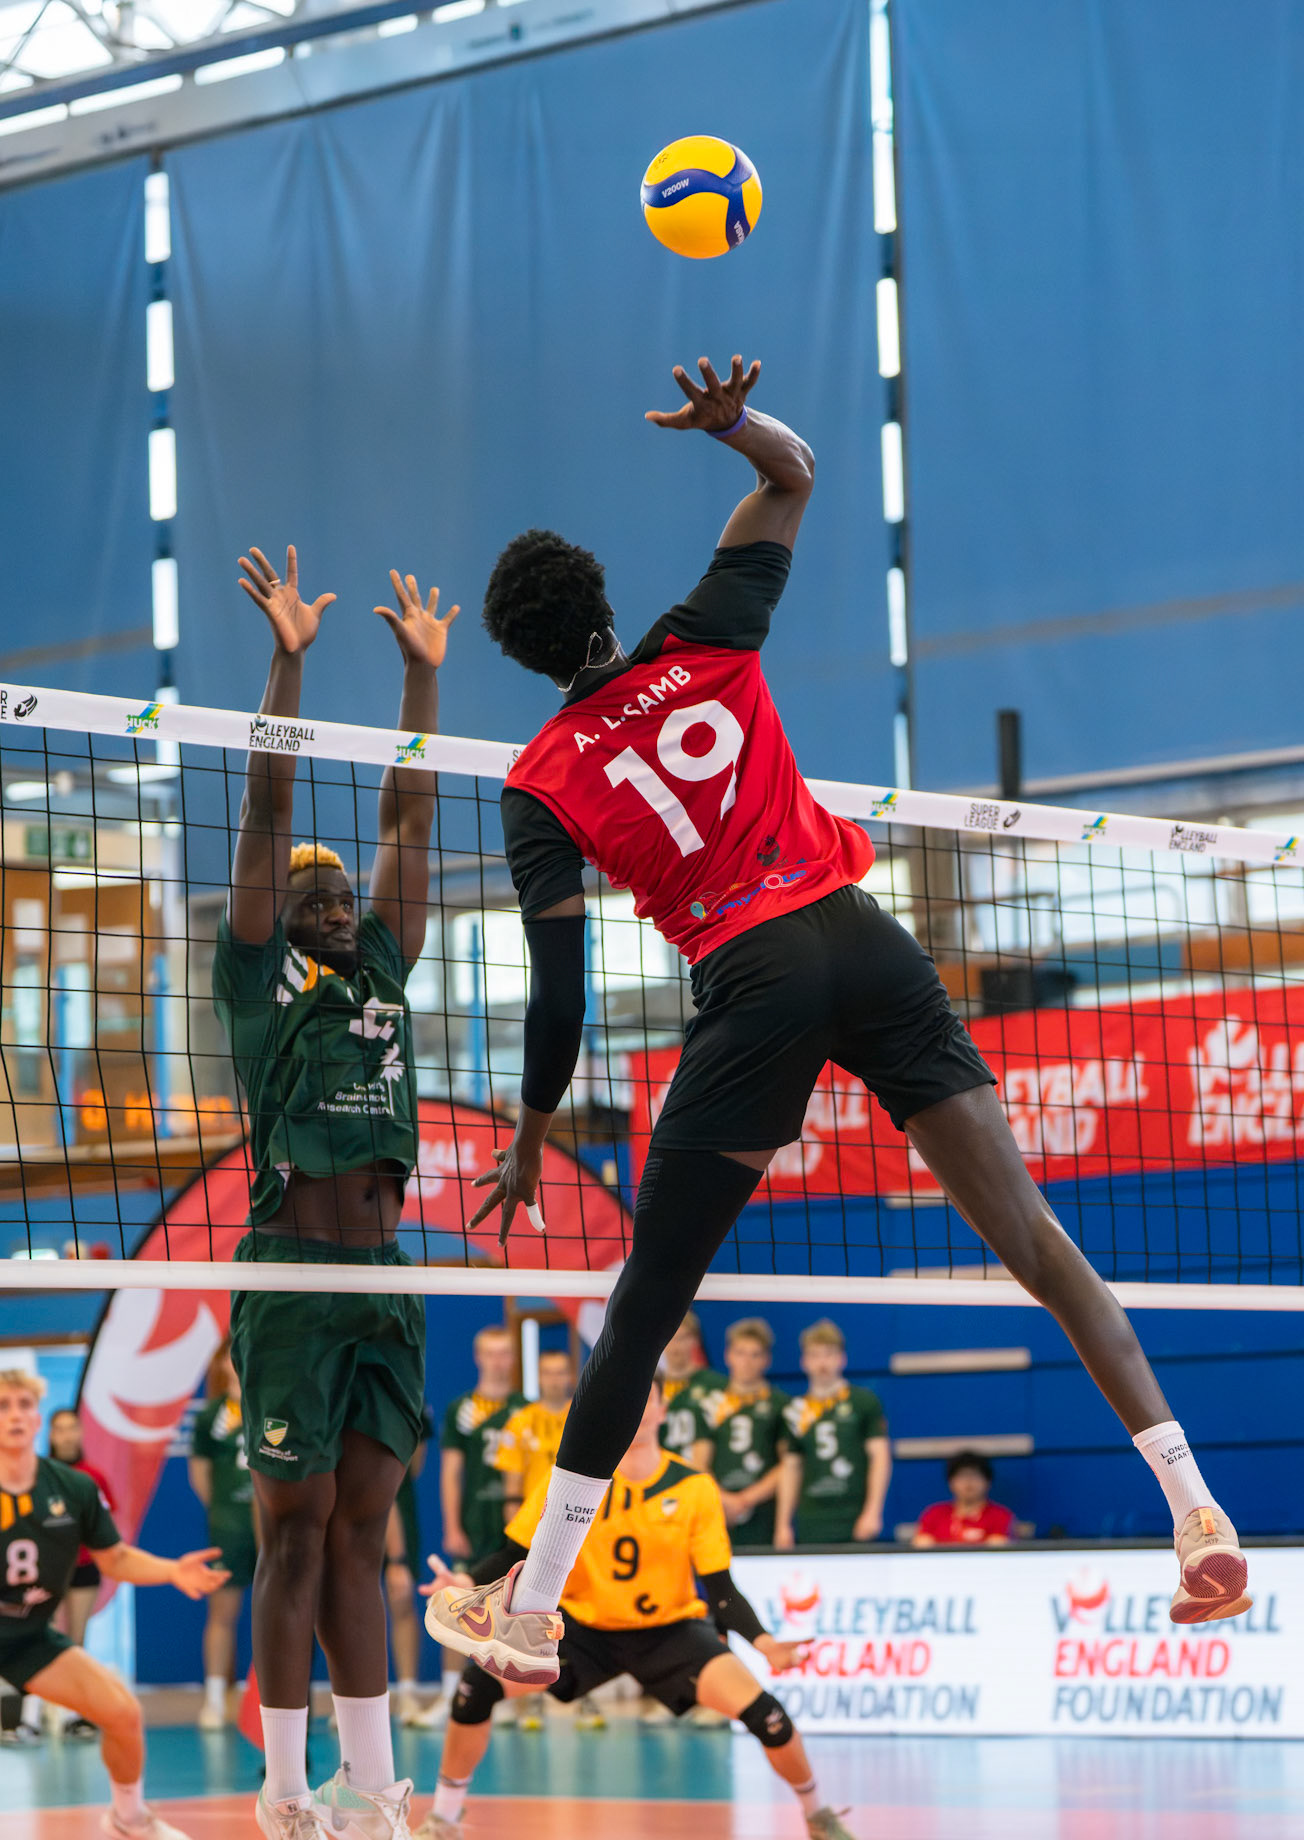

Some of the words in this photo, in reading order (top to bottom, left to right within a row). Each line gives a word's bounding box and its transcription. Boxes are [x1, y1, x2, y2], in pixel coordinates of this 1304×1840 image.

[661, 177, 690, 199] V200W
[249, 715, 315, 741] VOLLEYBALL
[249, 735, 301, 752] ENGLAND
[573, 730, 600, 754] A.
[602, 699, 745, 858] 19
[964, 815, 1000, 831] LEAGUE
[970, 803, 1001, 817] SUPER
[1169, 840, 1207, 853] ENGLAND
[1171, 824, 1217, 844] VOLLEYBALL
[728, 1414, 754, 1454] 3
[814, 1420, 839, 1460] 5
[566, 1513, 594, 1525] GIAN
[6, 1538, 40, 1587] 8
[612, 1535, 640, 1582] 9
[765, 1586, 978, 1635] VOLLEYBALL
[1053, 1638, 1232, 1678] ENGLAND
[1052, 1684, 1284, 1723] FOUNDATION
